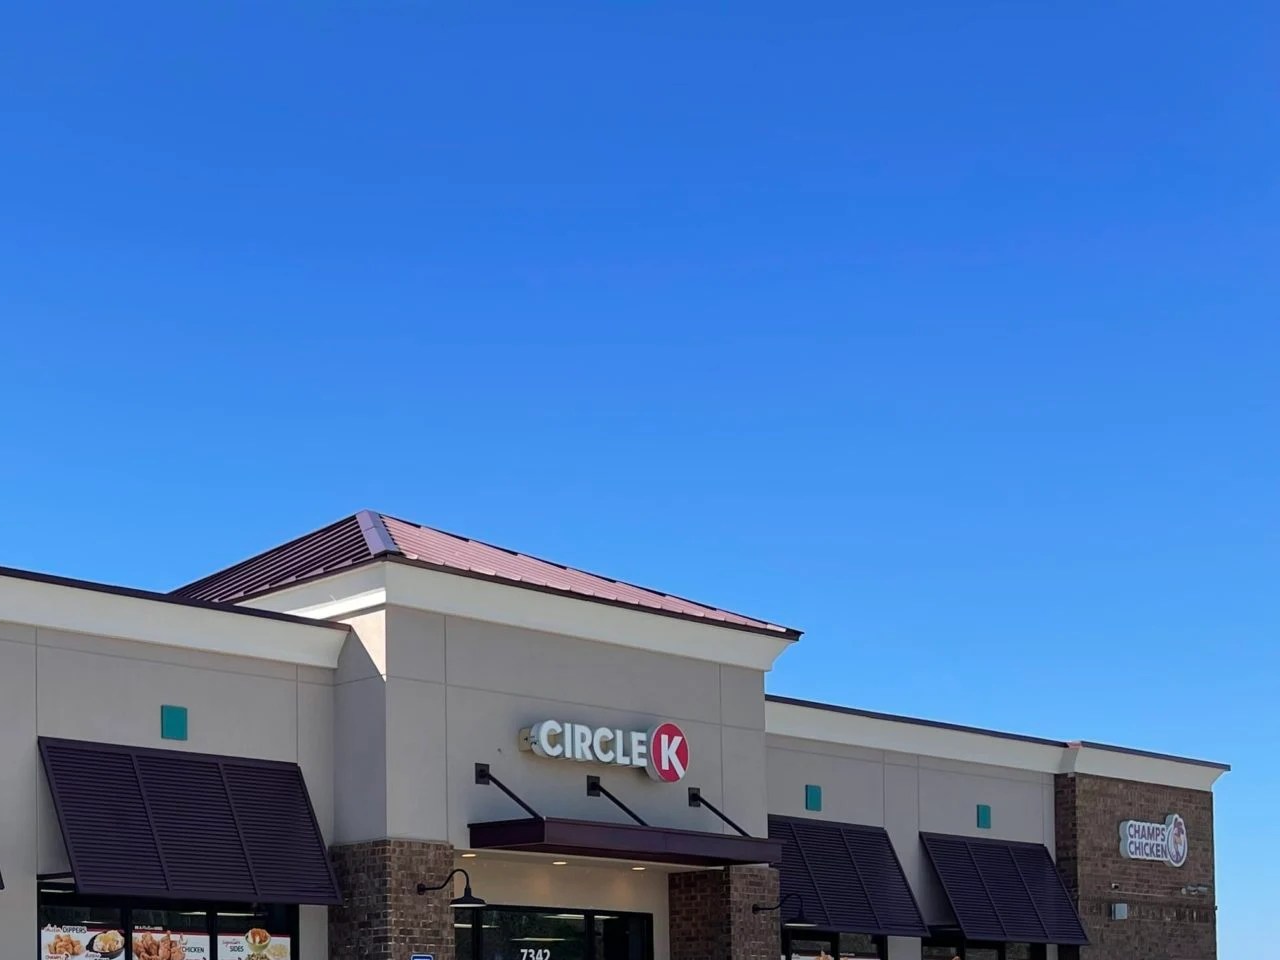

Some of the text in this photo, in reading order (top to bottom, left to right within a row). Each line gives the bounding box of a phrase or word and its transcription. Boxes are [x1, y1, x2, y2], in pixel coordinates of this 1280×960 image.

[540, 719, 686, 779] CIRCLE K
[1127, 823, 1166, 842] CHAMPS
[1127, 841, 1168, 859] CHICKEN
